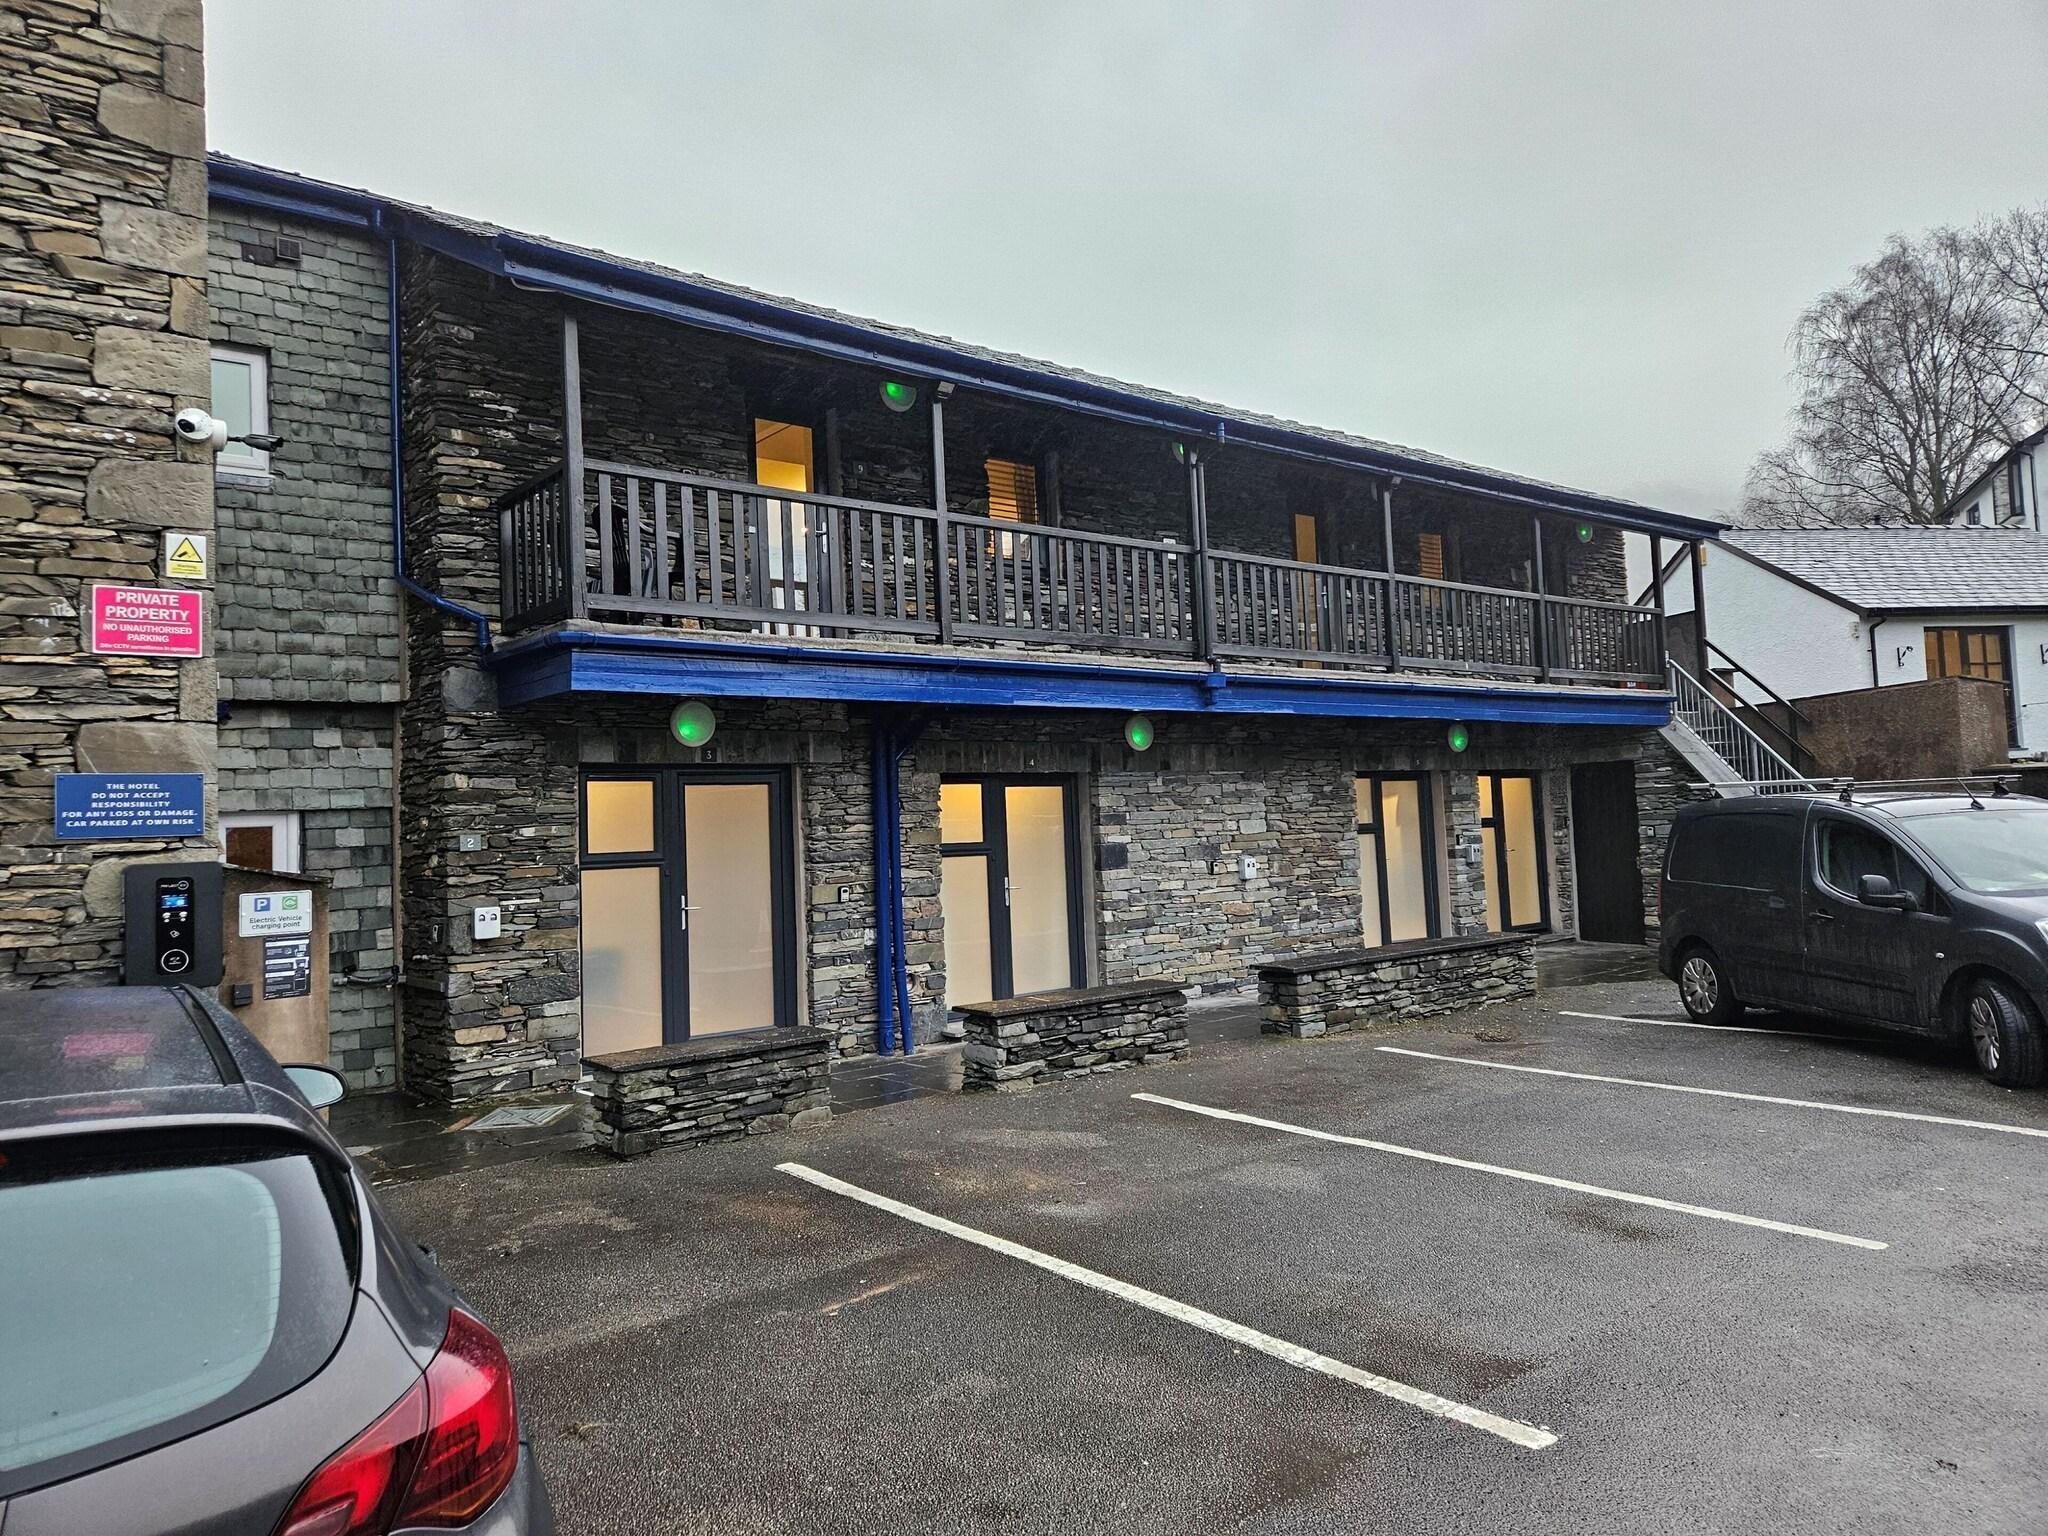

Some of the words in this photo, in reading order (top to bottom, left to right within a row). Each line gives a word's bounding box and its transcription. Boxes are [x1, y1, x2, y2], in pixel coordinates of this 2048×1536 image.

[115, 591, 180, 607] PRIVATE
[105, 605, 190, 621] PROPERTY
[103, 623, 118, 631] NO
[120, 624, 193, 635] UNAUTHORISED
[127, 633, 169, 643] PARKING
[705, 750, 712, 760] 3
[467, 838, 474, 848] 2
[256, 899, 268, 911] P
[251, 922, 281, 930] charging
